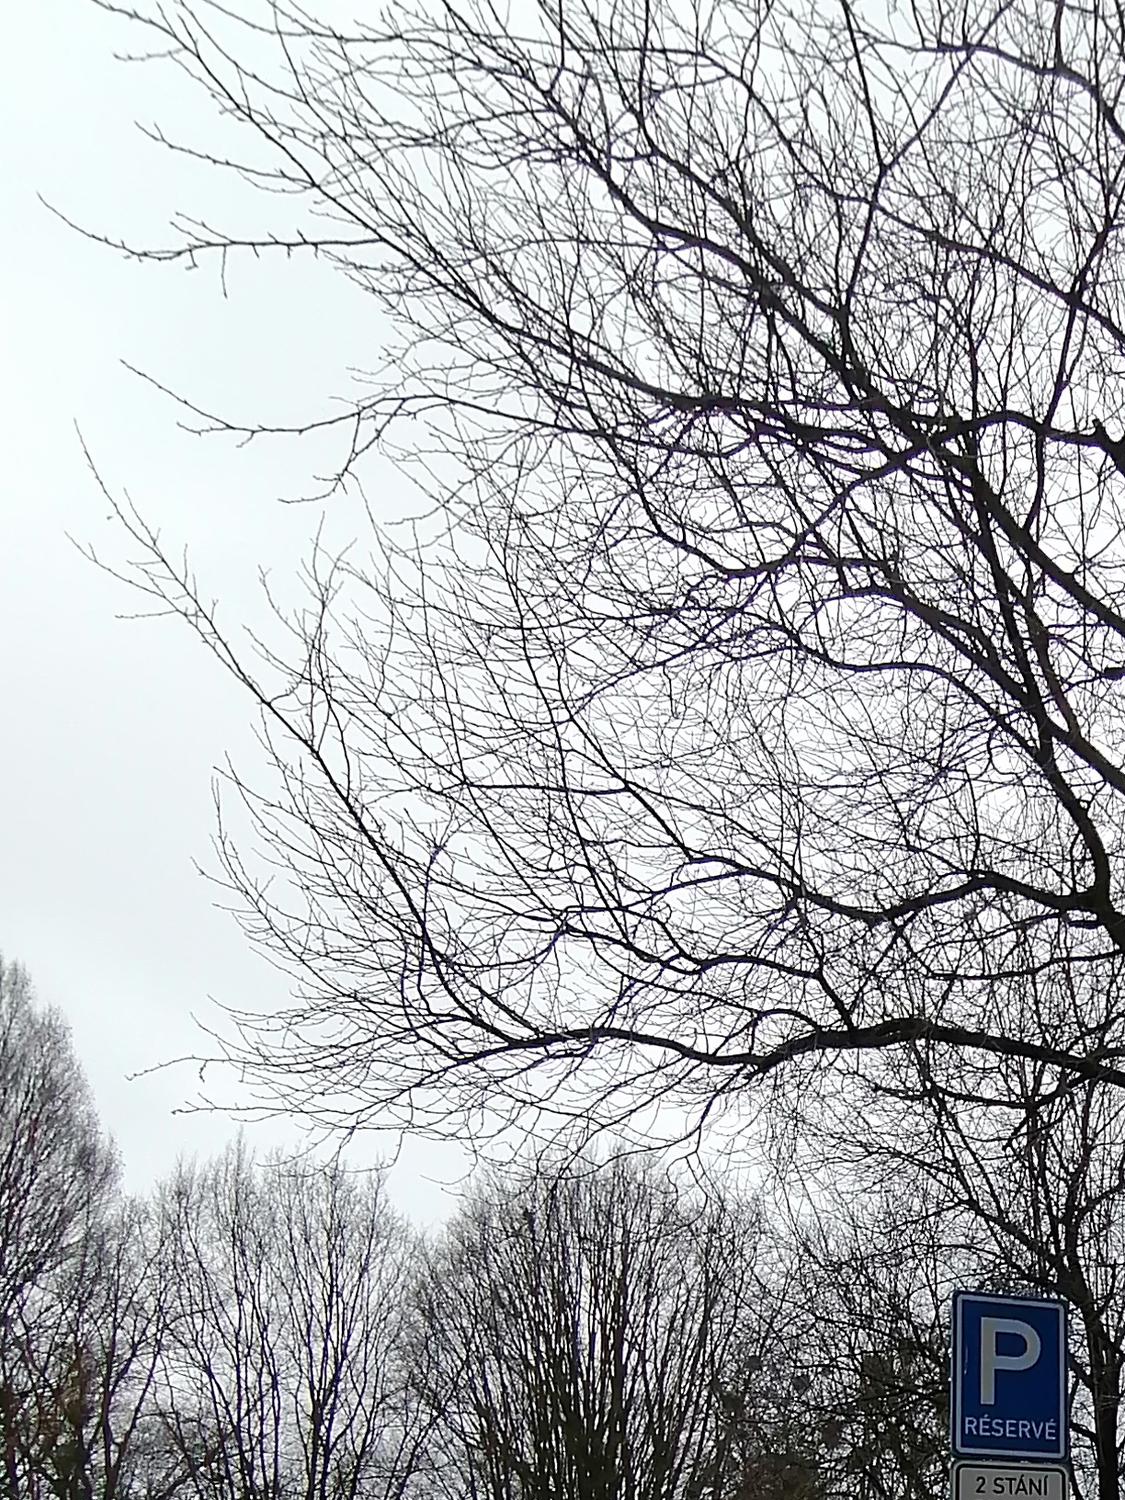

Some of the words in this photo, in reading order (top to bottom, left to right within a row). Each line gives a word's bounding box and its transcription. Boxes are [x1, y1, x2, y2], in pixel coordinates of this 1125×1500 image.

[980, 1316, 1041, 1405] P
[965, 1414, 1056, 1440] RÉSERVÉ
[975, 1476, 986, 1494] 2
[992, 1474, 1049, 1496] STÁNÍ
